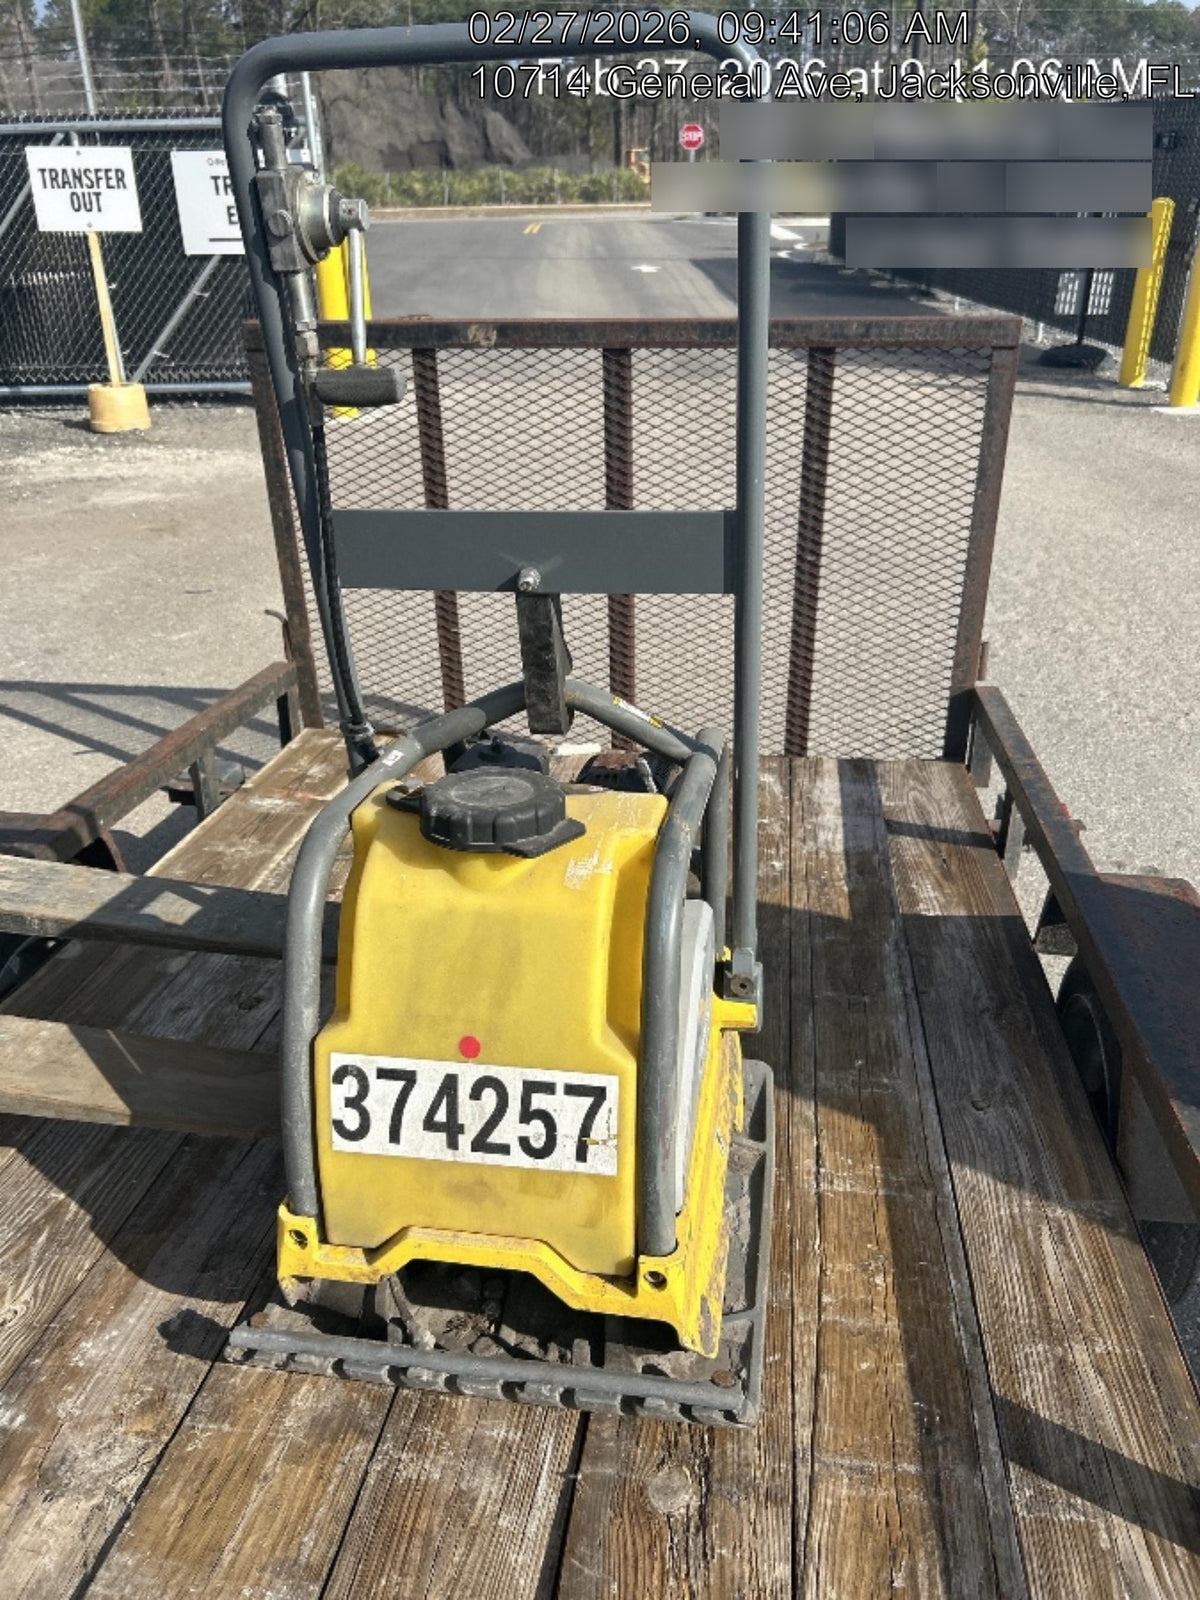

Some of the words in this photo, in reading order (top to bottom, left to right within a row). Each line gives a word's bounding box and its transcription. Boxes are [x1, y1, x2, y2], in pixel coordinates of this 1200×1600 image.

[38, 168, 127, 189] TRANSFER
[70, 191, 102, 212] OUT
[331, 1064, 607, 1163] 374257
